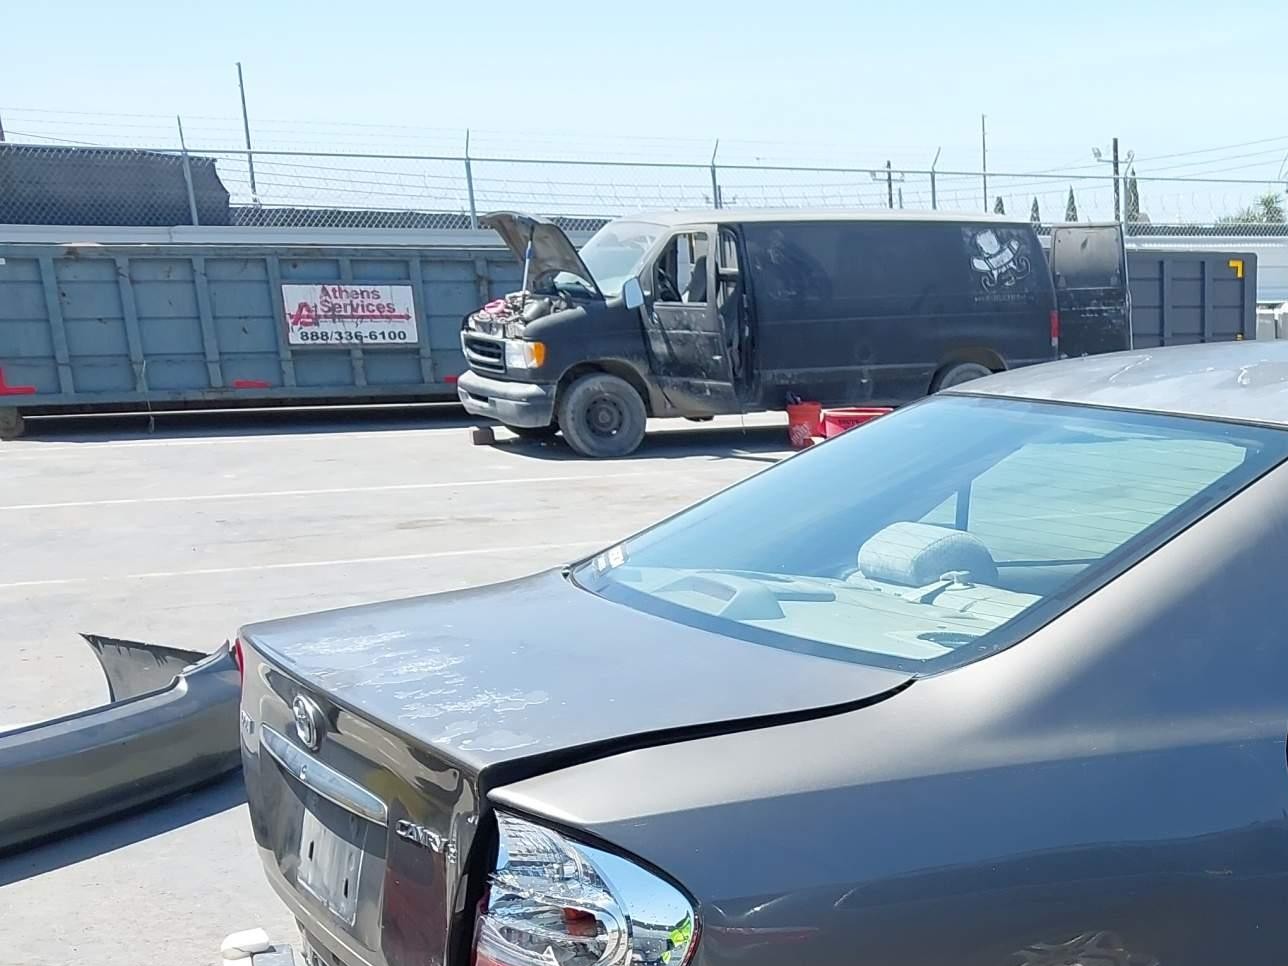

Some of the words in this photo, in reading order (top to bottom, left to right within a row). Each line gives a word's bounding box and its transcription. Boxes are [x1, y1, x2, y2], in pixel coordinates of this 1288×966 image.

[319, 285, 382, 300] Athens
[319, 299, 396, 314] Services
[300, 330, 407, 341] 888/336-6100
